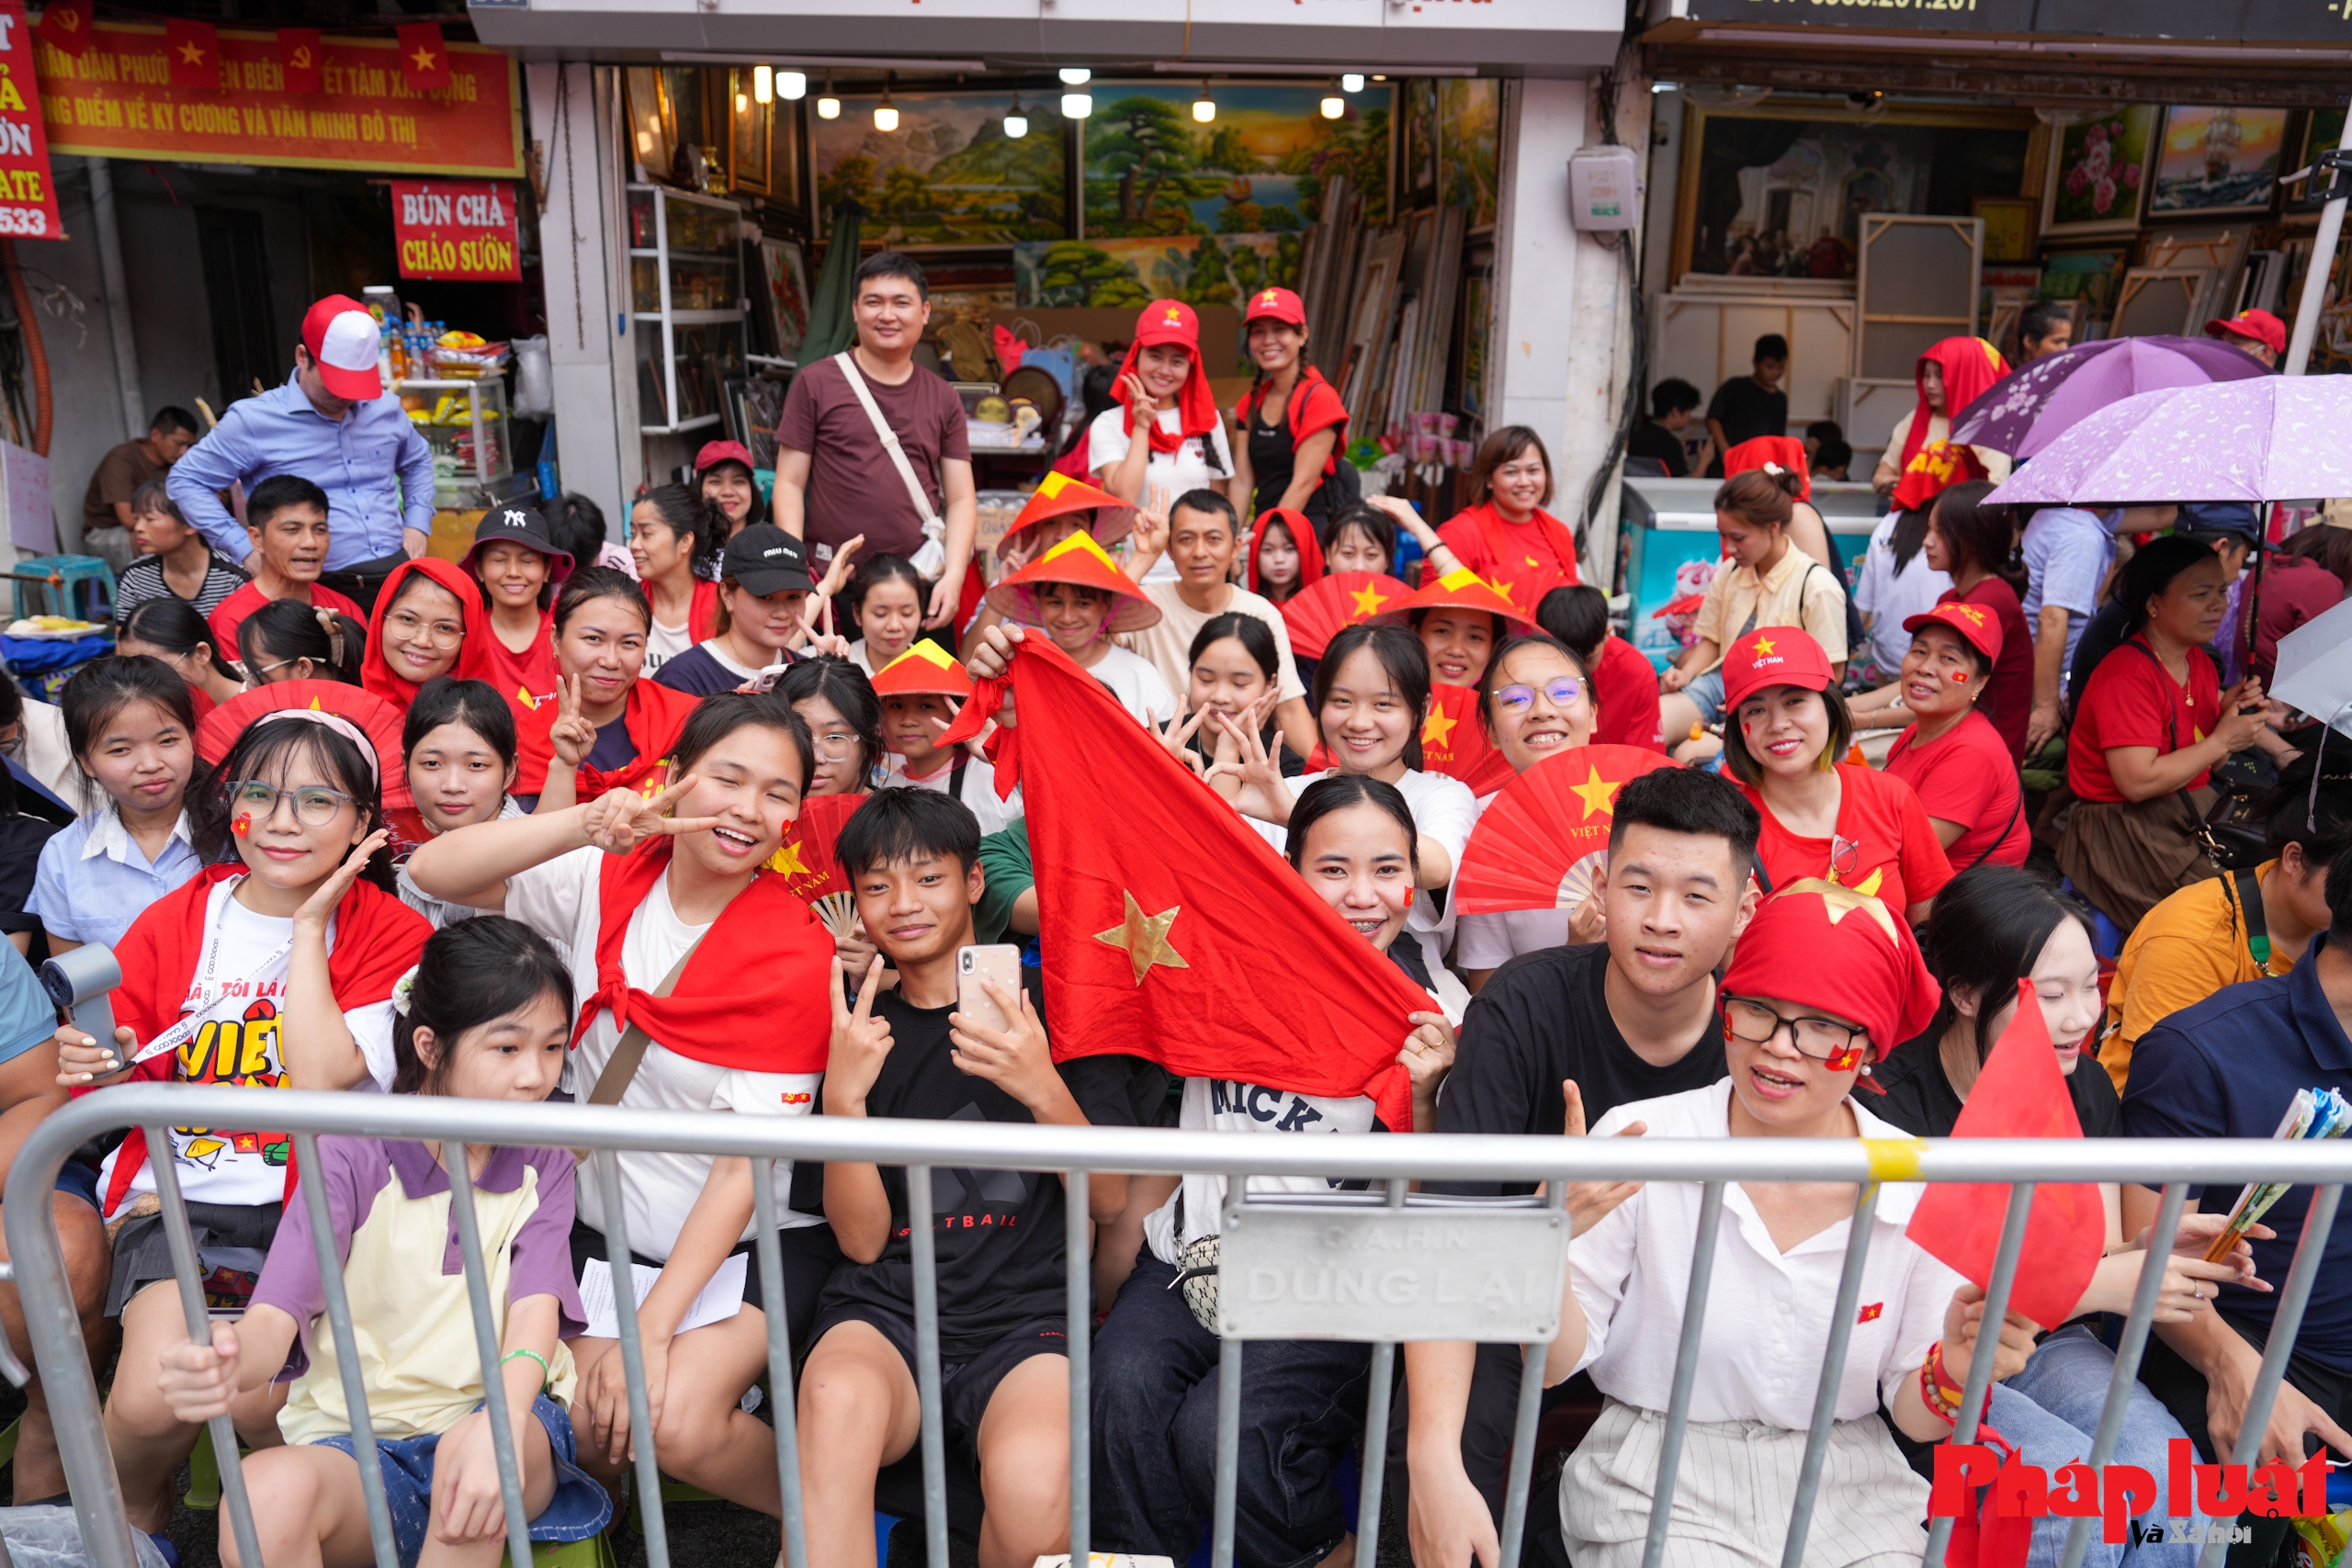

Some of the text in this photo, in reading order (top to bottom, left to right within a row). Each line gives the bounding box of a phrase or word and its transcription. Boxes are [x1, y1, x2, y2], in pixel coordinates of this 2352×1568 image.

[348, 62, 386, 97] TÂM
[74, 86, 122, 128] ĐIỂM
[126, 92, 149, 130] VỀ
[153, 90, 175, 131] KỶ
[179, 103, 241, 135] CƯƠNG
[243, 102, 268, 136] VÀ
[270, 104, 307, 137] VĂN
[311, 110, 358, 141] MINH
[361, 109, 384, 141] ĐÔ
[388, 116, 417, 150] THỊ
[401, 183, 505, 227] BÚN CHẢ
[402, 231, 513, 272] CHÁO SƯỜN
[1752, 656, 1784, 670] VIỆT NAM
[1571, 825, 1600, 839] VIỆT
[803, 870, 831, 891] NAM
[221, 977, 250, 998] TÔI
